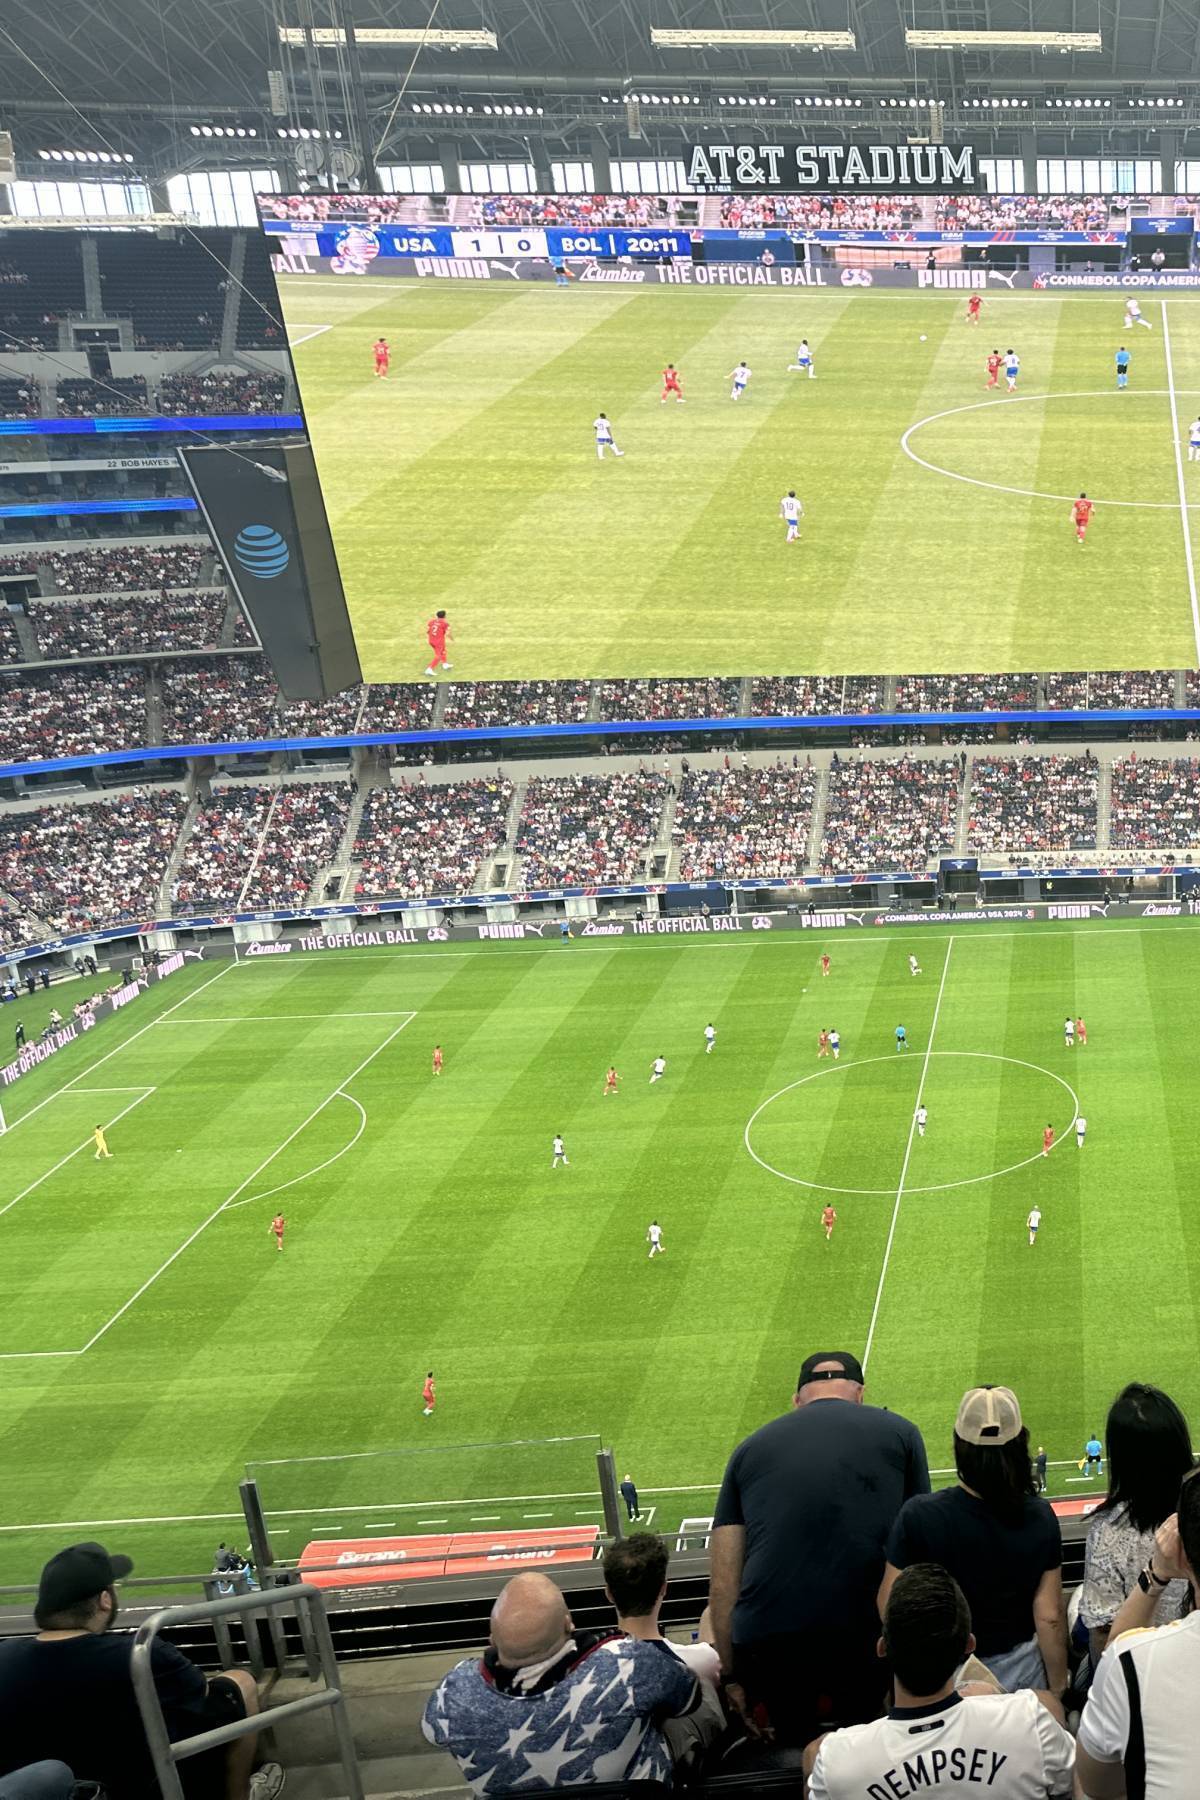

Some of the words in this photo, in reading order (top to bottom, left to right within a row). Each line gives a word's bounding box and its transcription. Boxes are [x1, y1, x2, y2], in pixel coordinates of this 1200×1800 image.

[687, 145, 785, 184] AT&T
[796, 145, 975, 184] STADIUM
[393, 238, 436, 252] USA
[471, 240, 481, 252] 1
[517, 239, 531, 252] 0
[561, 237, 602, 252] BOL
[626, 237, 678, 253] 20:11
[414, 257, 491, 279] PUMA
[580, 264, 645, 282] Cumbre
[655, 265, 691, 284] THE
[695, 265, 777, 285] OFFICIAL
[781, 267, 827, 286] BALL
[917, 269, 986, 288] PUMA
[1050, 273, 1121, 287] CONMEBOL
[1122, 274, 1156, 286] COPA
[885, 913, 930, 923] CONMEBOL
[930, 912, 952, 921] COPA
[952, 911, 987, 920] AMERICA
[1048, 905, 1090, 919] PUMA
[631, 919, 655, 933] THE
[657, 918, 711, 933] OFFICIAL
[713, 917, 743, 931] BALL
[801, 914, 846, 928] PUMA
[478, 923, 525, 939] PUMA
[299, 936, 325, 951] THE
[327, 932, 384, 949] OFFICIAL
[386, 929, 419, 944] BALL
[1, 1062, 21, 1086] THE
[19, 1042, 58, 1073] OFFICIAL
[56, 1024, 78, 1048] BALL
[866, 1747, 1008, 1800] DEMPSEY
